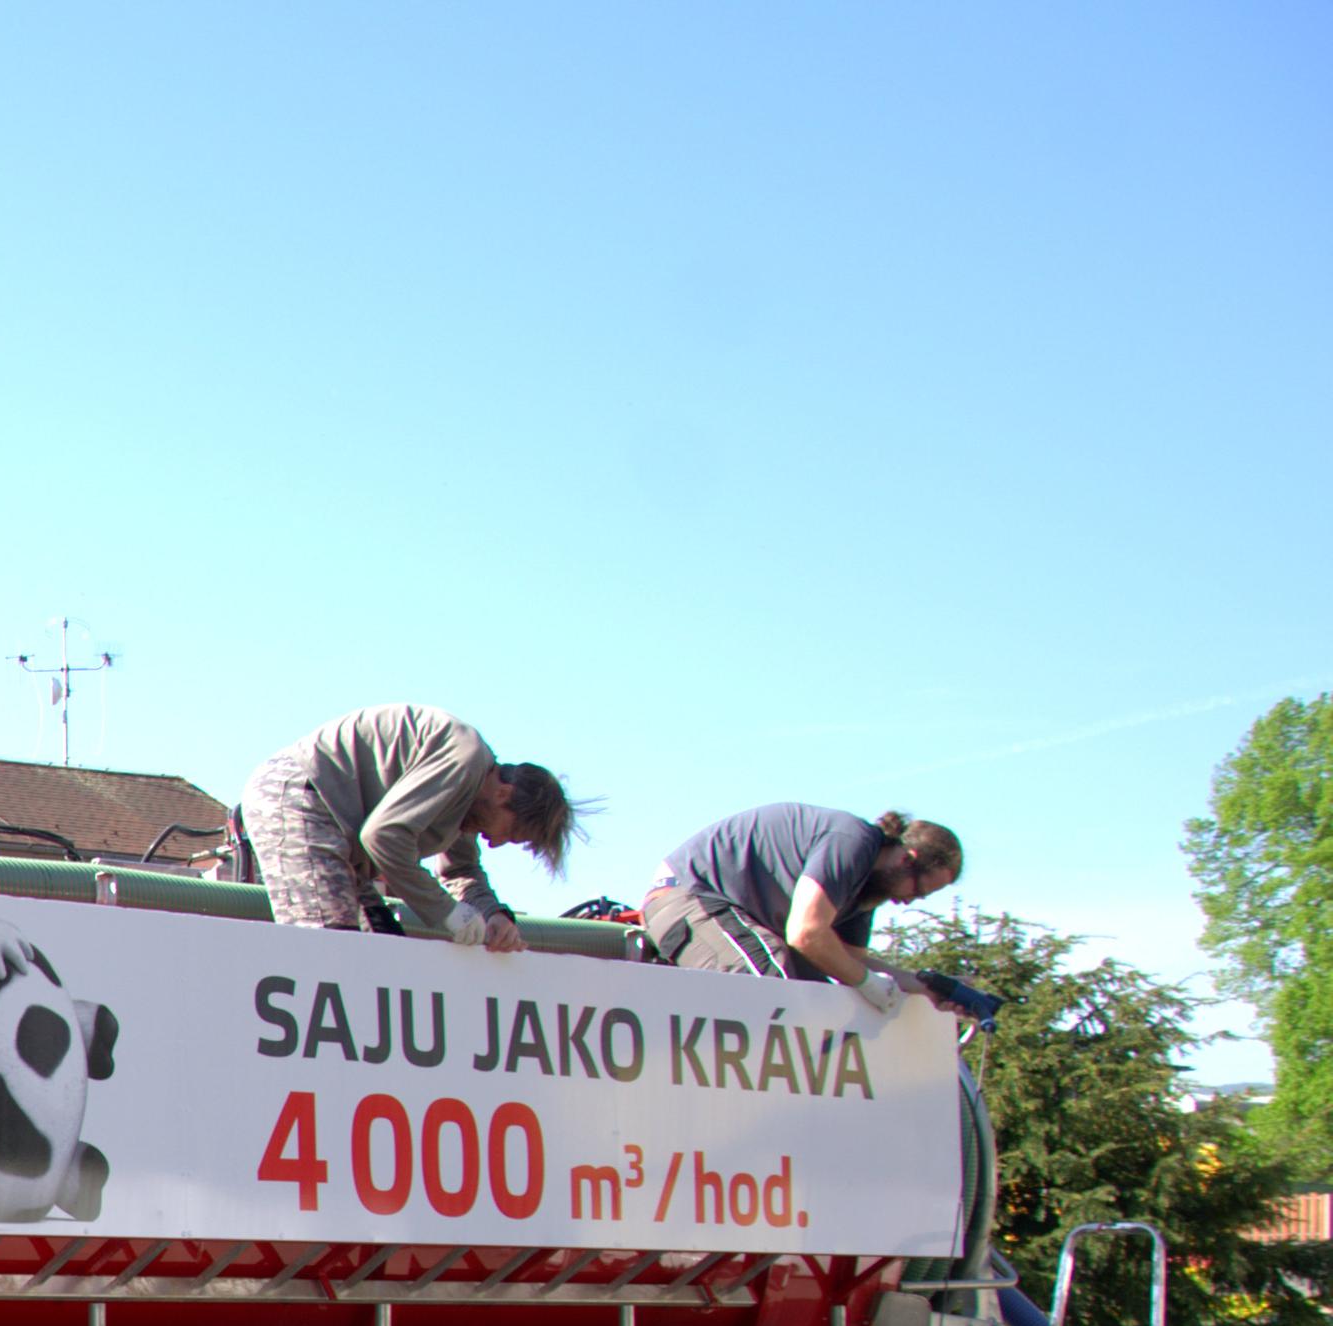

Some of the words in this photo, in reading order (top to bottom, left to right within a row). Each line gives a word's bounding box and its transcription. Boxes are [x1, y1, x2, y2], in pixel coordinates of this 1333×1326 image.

[254, 975, 447, 1068] SAJU
[473, 996, 645, 1083] JAKO
[669, 1007, 875, 1101] KRÁVA
